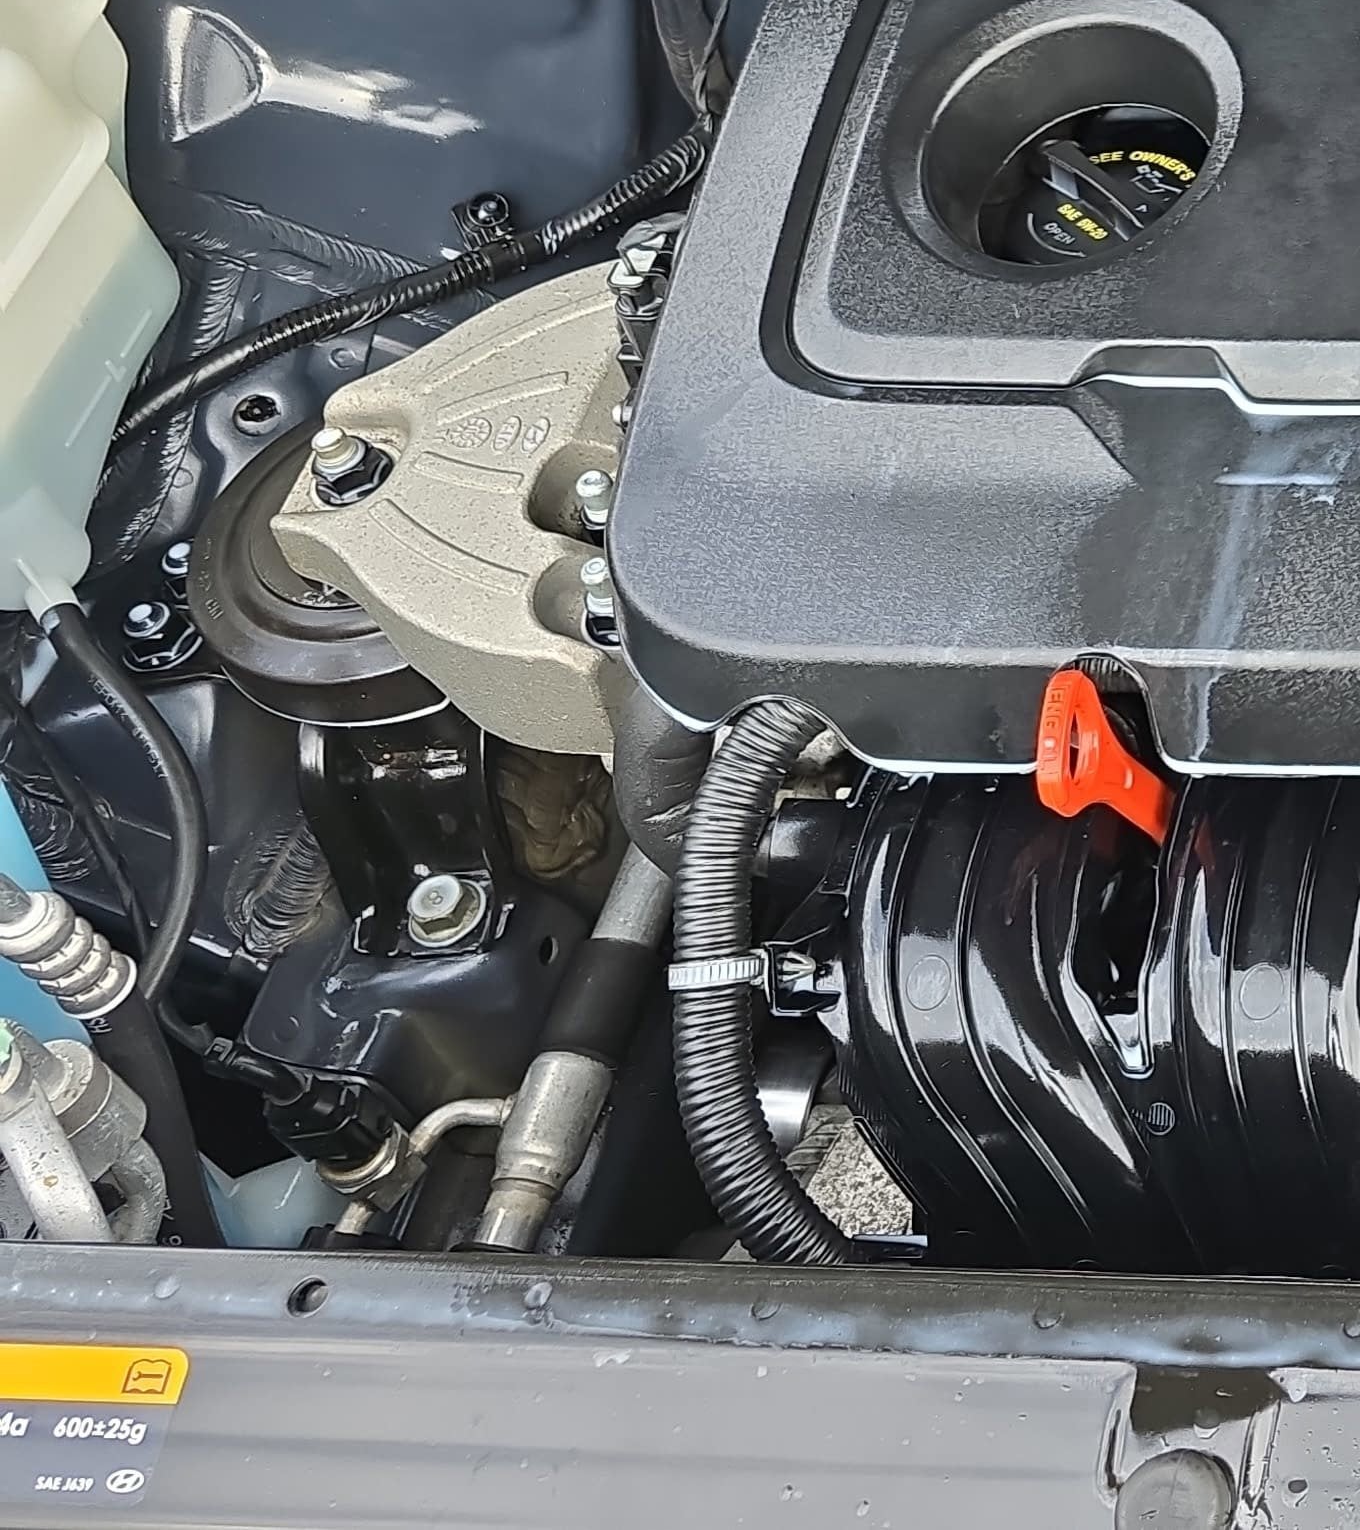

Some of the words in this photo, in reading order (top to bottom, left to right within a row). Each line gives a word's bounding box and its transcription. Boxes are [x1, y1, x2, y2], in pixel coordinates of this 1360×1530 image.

[1089, 151, 1124, 164] SEE
[1129, 150, 1197, 181] OWNER'S
[1043, 222, 1076, 245] OPEN
[53, 1416, 148, 1446] 600±25g
[34, 1475, 62, 1491] SAE
[61, 1476, 96, 1492] J639
